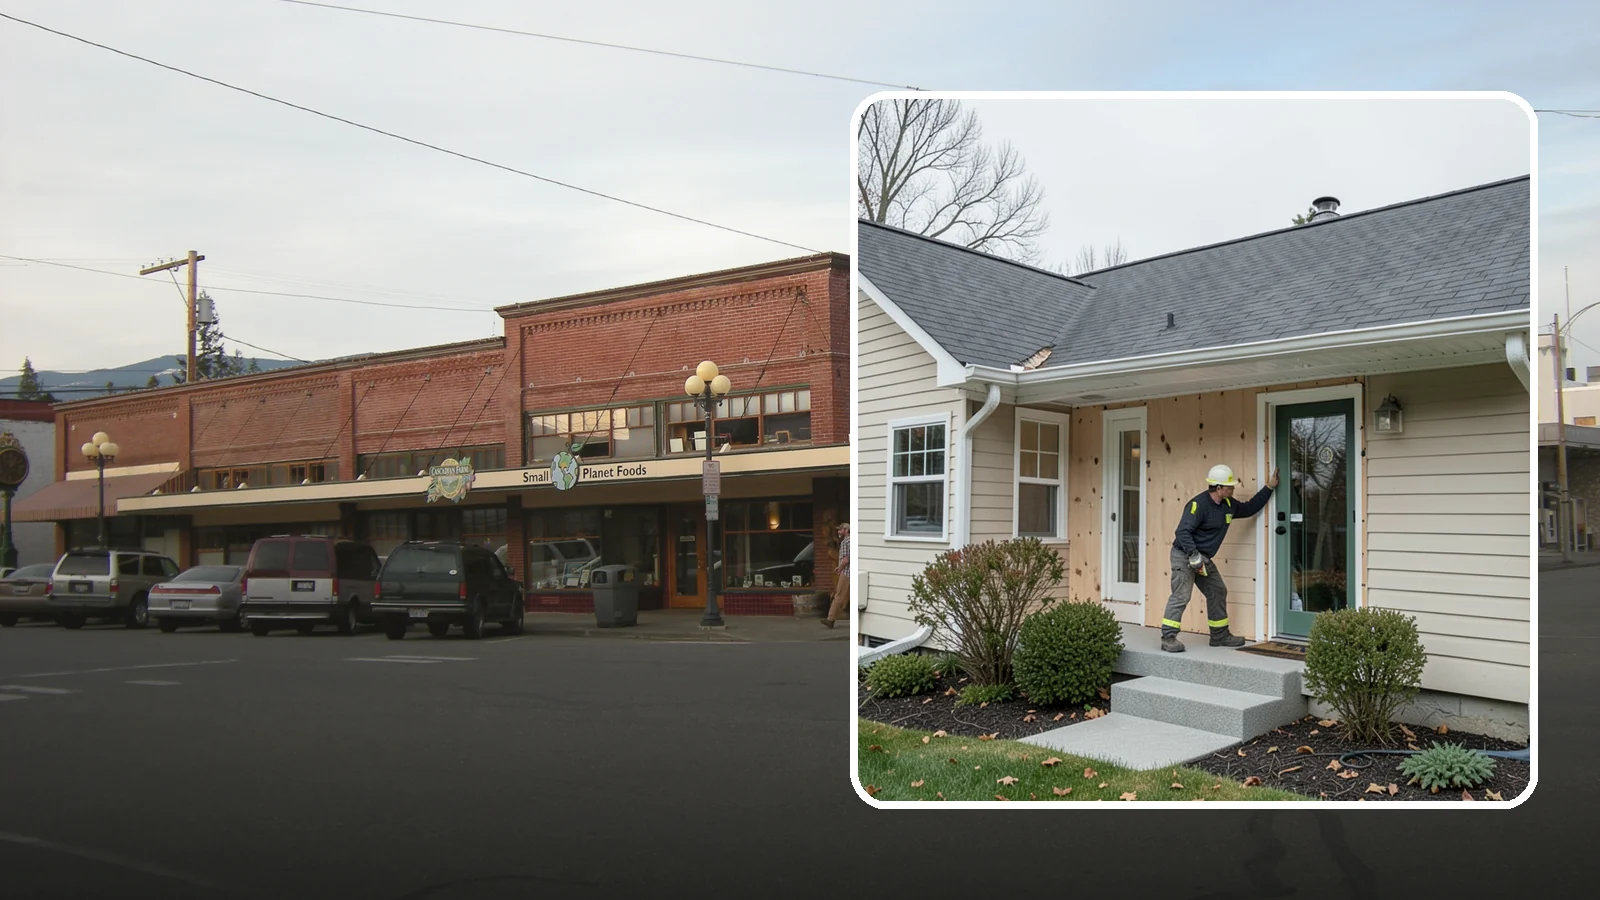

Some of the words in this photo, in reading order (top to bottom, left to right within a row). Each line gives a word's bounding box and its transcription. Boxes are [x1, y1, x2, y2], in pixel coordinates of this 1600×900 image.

[523, 471, 549, 483] Small
[583, 467, 614, 479] Planet
[617, 464, 647, 477] Foods
